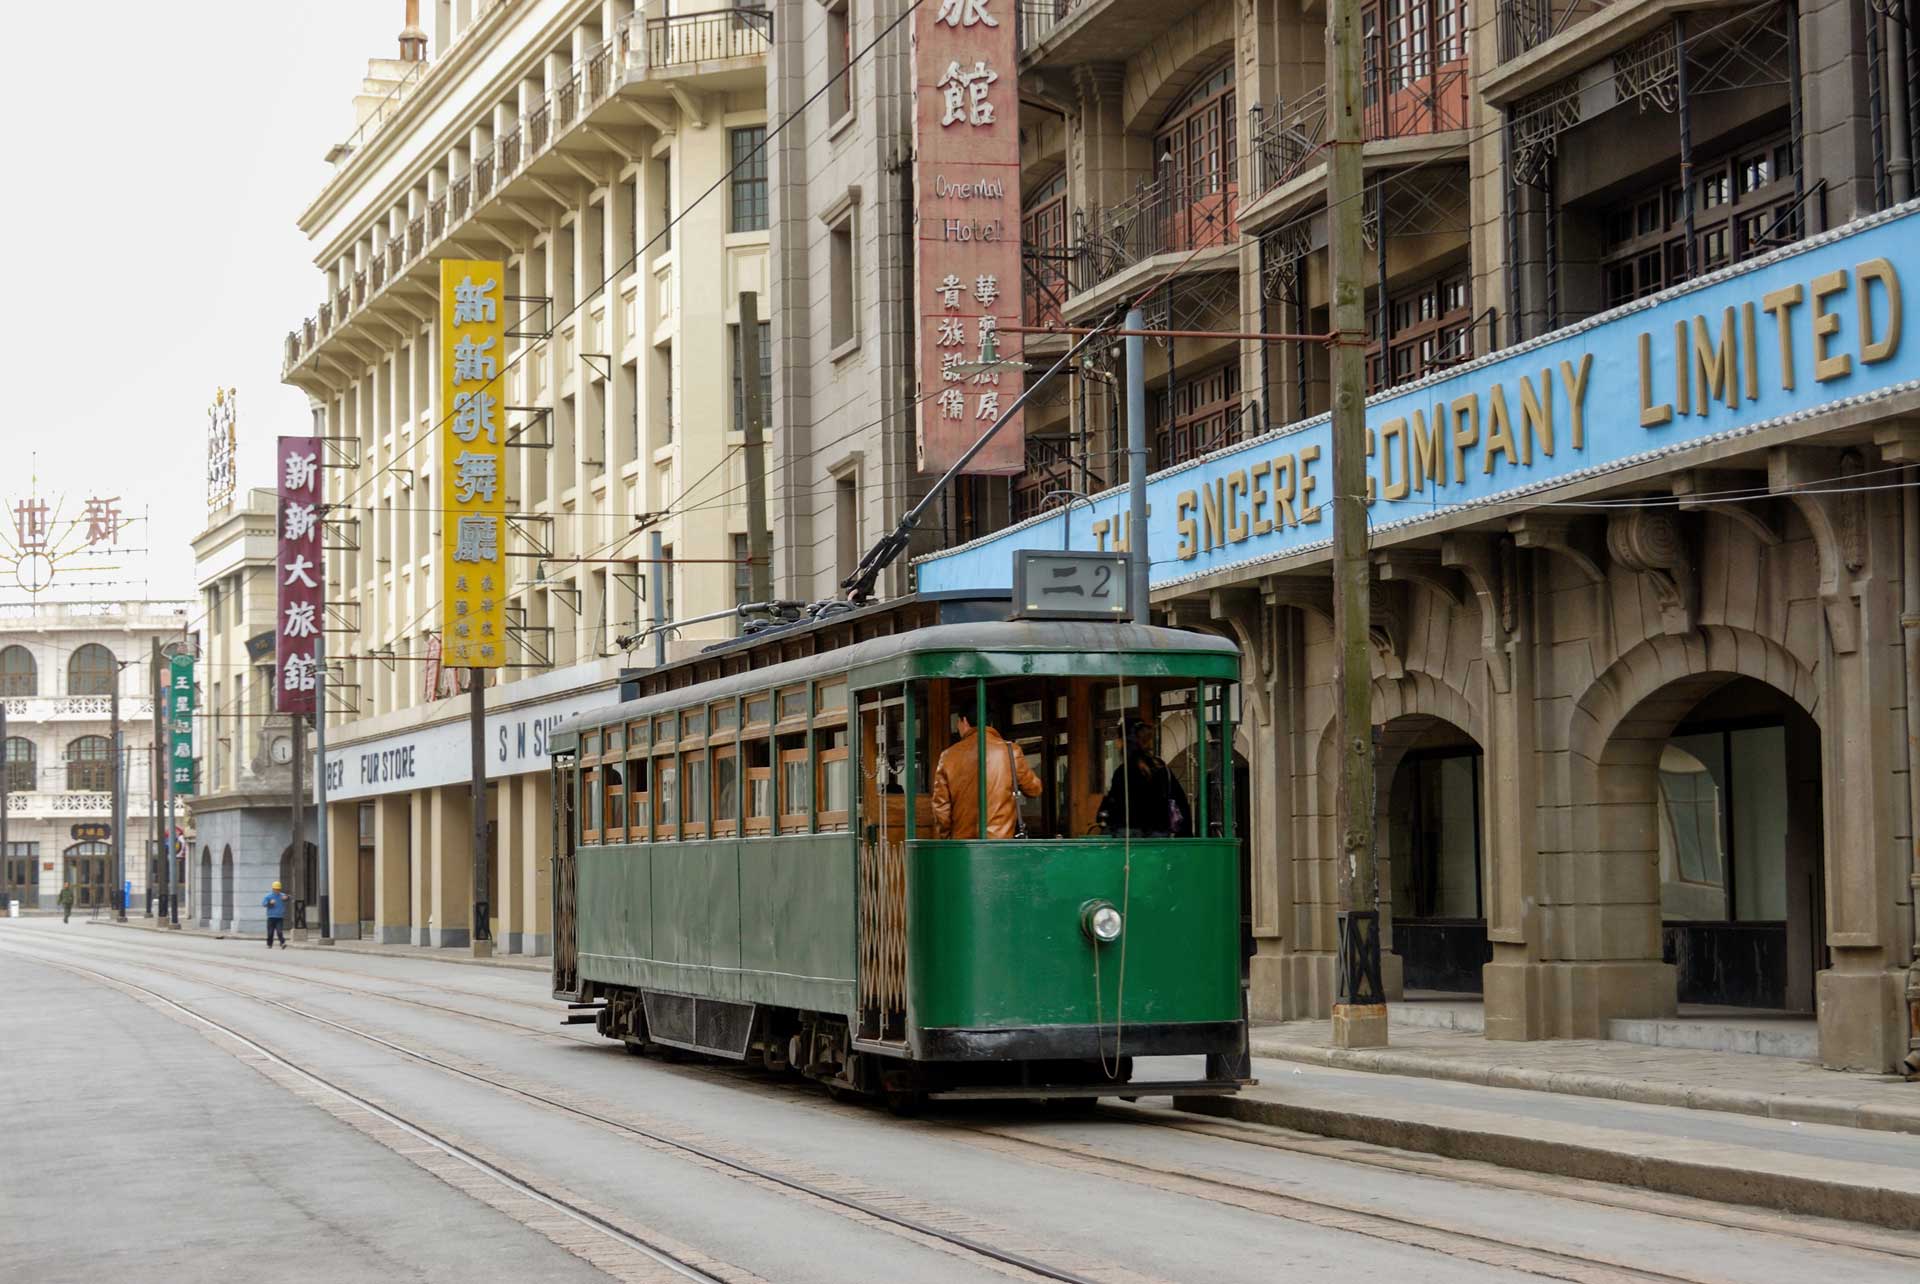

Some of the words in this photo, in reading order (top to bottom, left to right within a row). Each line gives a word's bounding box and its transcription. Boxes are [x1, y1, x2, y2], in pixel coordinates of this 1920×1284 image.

[944, 217, 1001, 241] Hotel
[1366, 352, 1594, 508] OMPANY
[1638, 256, 1900, 428] LIMITED
[452, 275, 498, 563] 新新跳舞廳
[1091, 565, 1111, 598] 2
[360, 752, 380, 785] FUR
[382, 744, 416, 783] STORE
